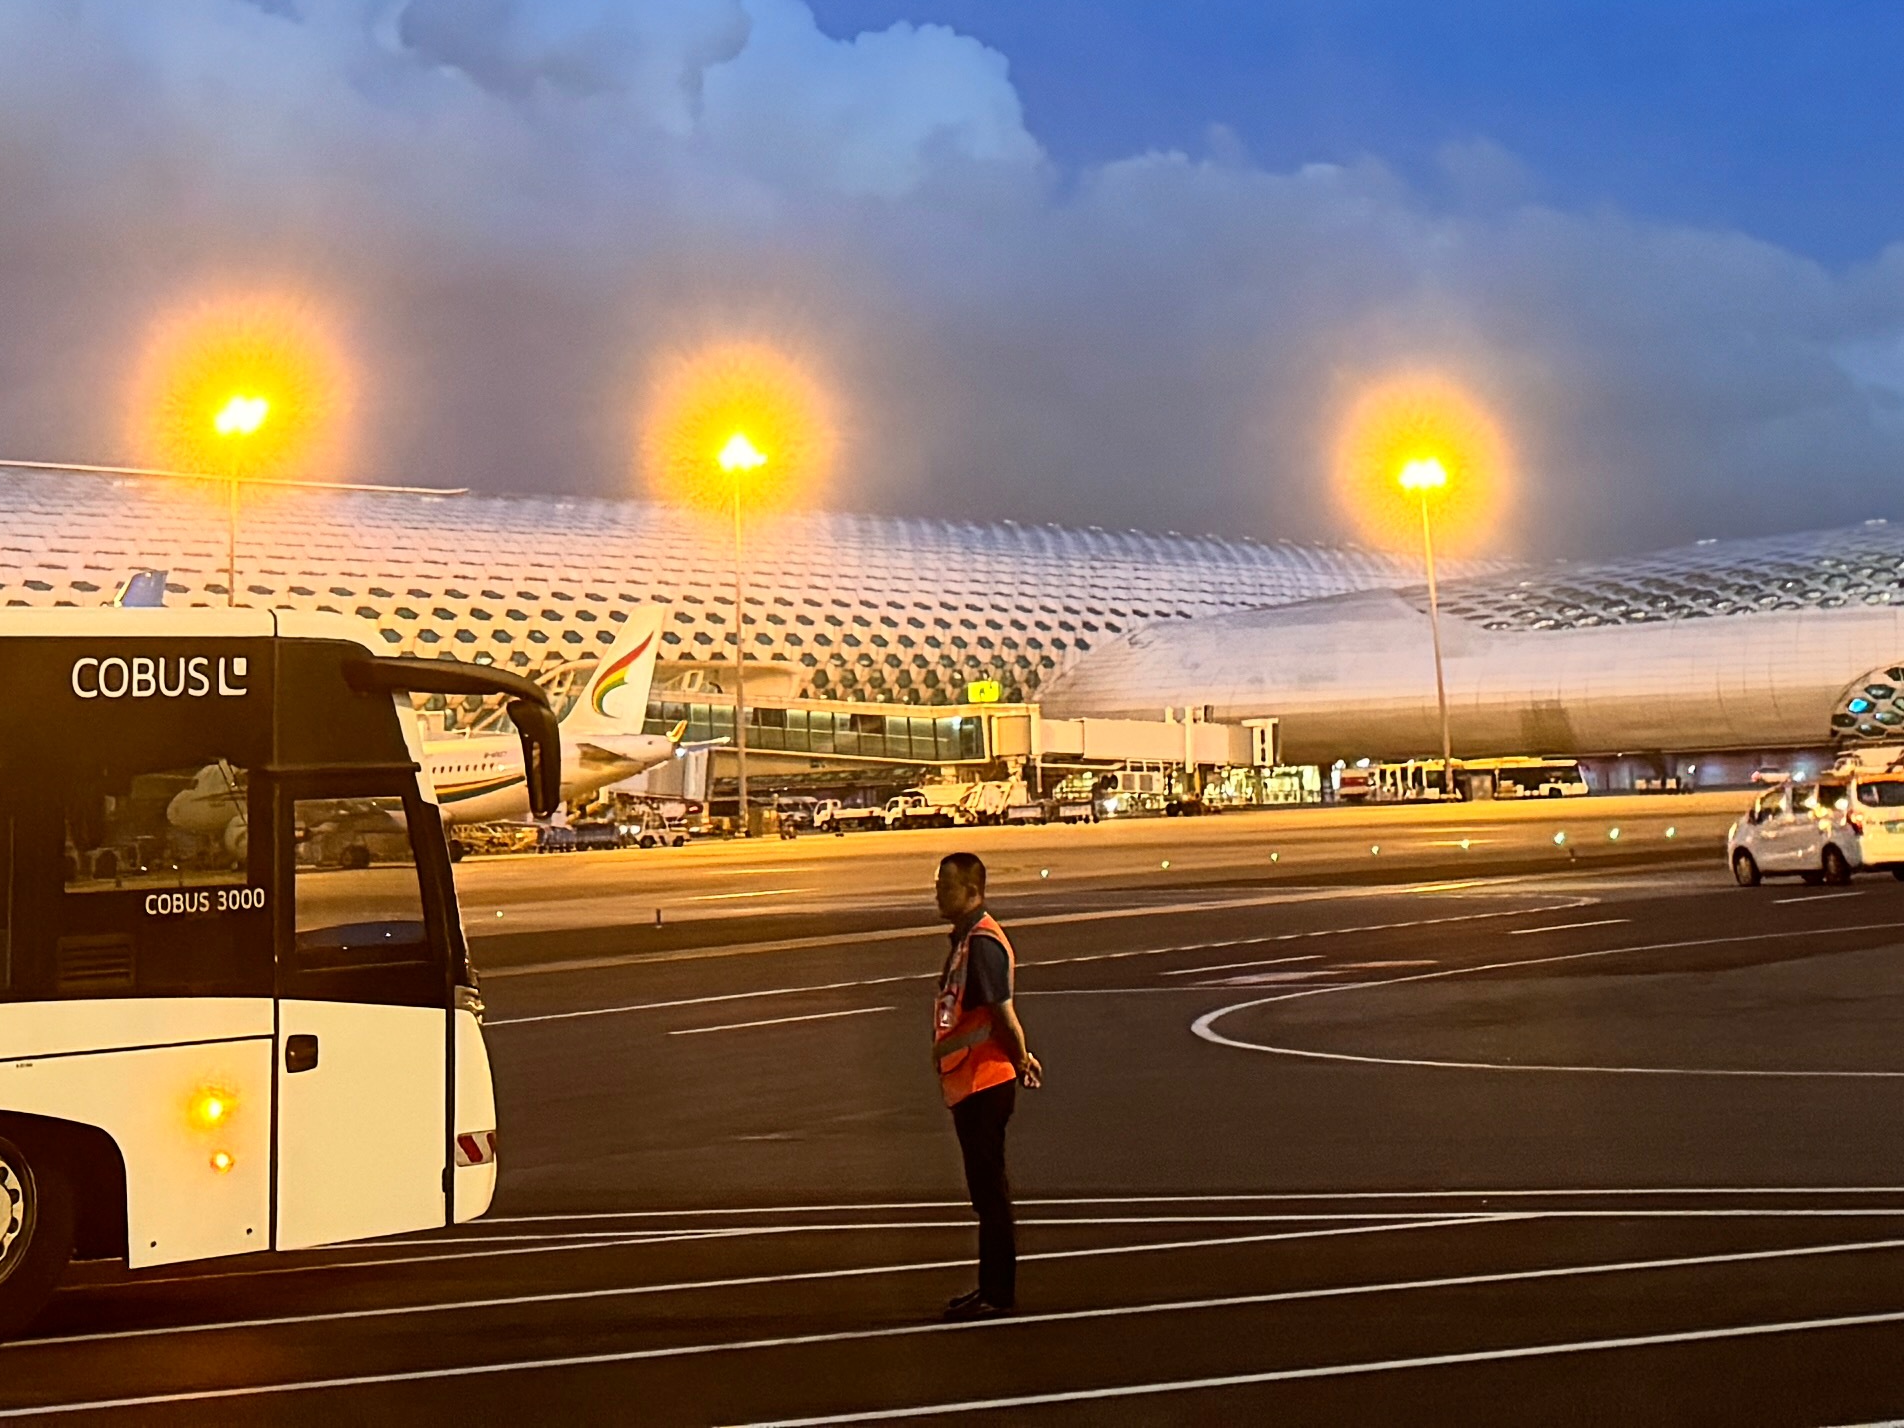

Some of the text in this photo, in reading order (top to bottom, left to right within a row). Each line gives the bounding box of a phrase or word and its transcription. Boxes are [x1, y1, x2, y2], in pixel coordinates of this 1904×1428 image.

[71, 657, 210, 698] COBUS
[145, 888, 265, 915] COBUS 3000
